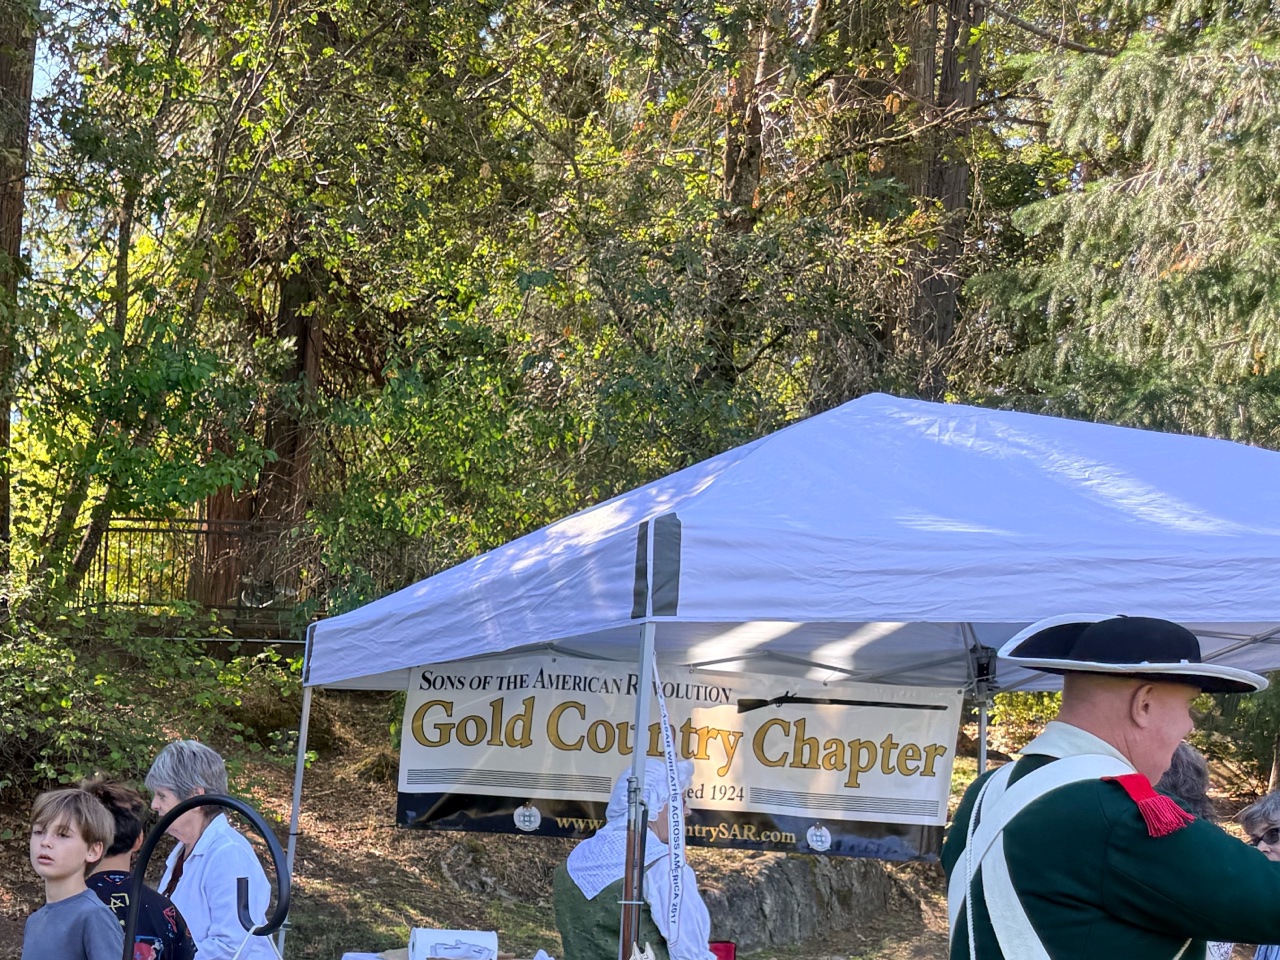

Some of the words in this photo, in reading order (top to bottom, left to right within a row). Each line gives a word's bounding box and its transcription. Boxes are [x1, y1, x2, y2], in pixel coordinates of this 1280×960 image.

[419, 669, 466, 691] SONS
[469, 674, 493, 691] OF
[496, 674, 529, 691] THE
[531, 667, 623, 695] AMERICAN
[625, 673, 732, 704] RVOLUTION
[411, 696, 536, 749] Gold
[752, 717, 948, 788] Chapter
[666, 750, 679, 803] WREATHS
[710, 784, 745, 801] 1924
[671, 805, 680, 850] ACROSS
[671, 852, 680, 900] AMERICA
